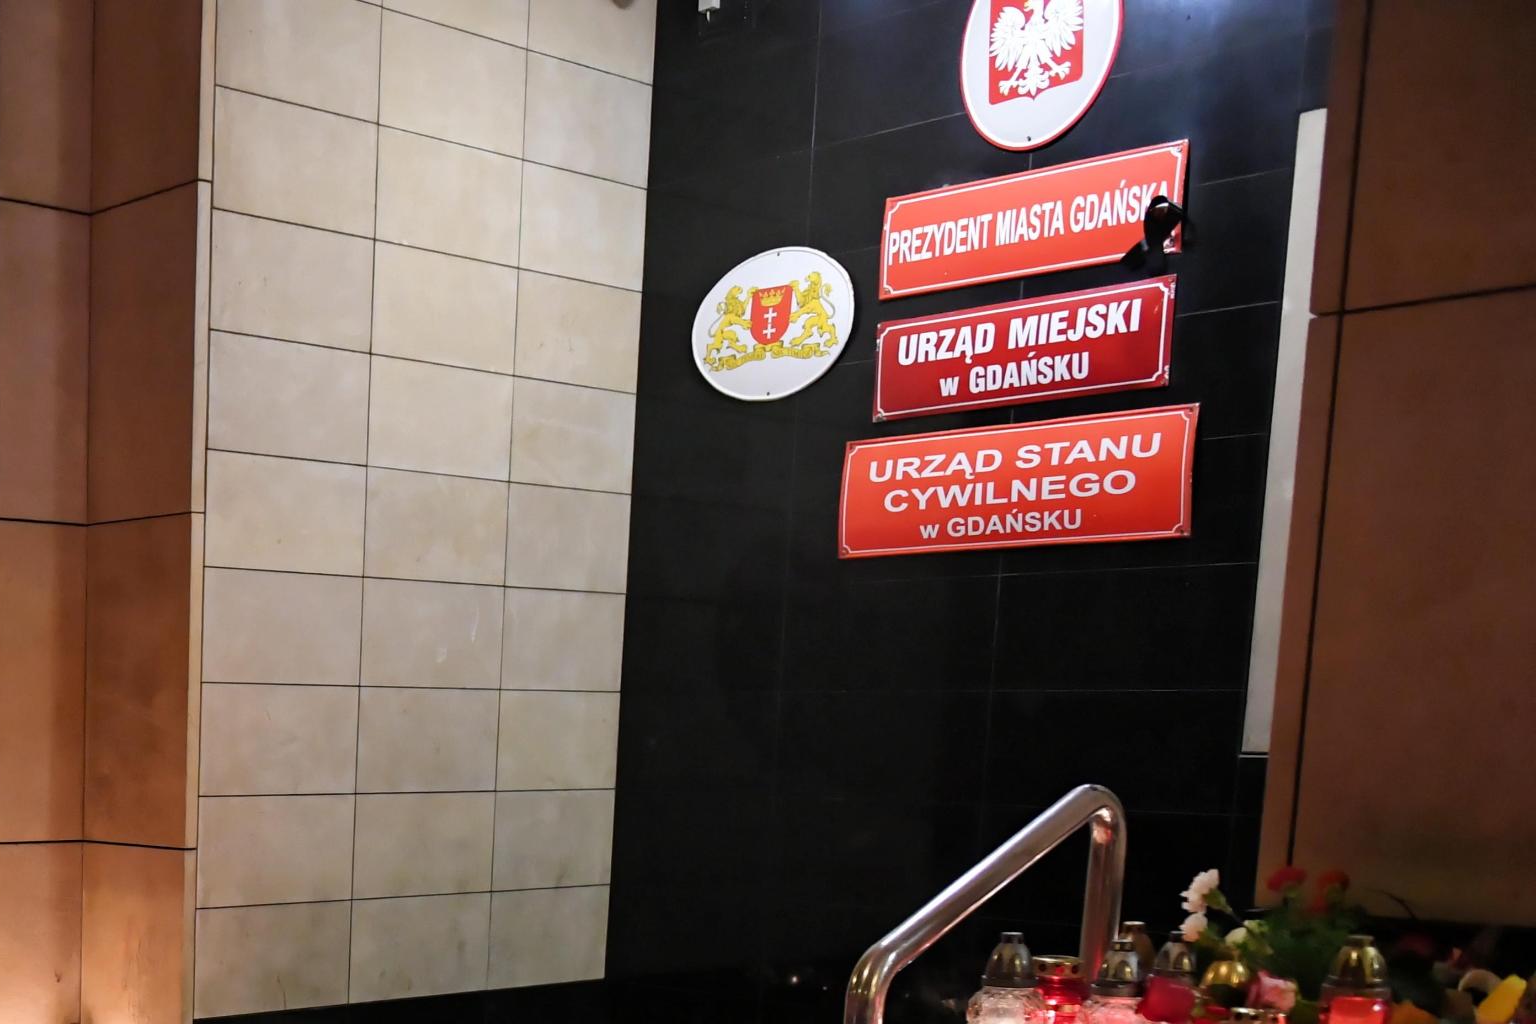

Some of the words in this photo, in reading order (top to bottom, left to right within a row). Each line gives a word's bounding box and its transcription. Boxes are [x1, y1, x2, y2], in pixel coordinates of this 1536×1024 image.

[888, 213, 992, 265] PREZYDENT
[995, 200, 1064, 246] MIASTA
[898, 322, 995, 366] URZĄD
[1007, 298, 1143, 350] MIEJSKI
[939, 376, 959, 397] w
[969, 351, 1090, 394] GDAŃSKU
[869, 449, 1003, 482] URZĄD
[1015, 432, 1162, 469] STANU
[883, 470, 1136, 513] CYWILNEGO
[919, 523, 939, 539] w
[947, 508, 1082, 538] GDAŃSKU
